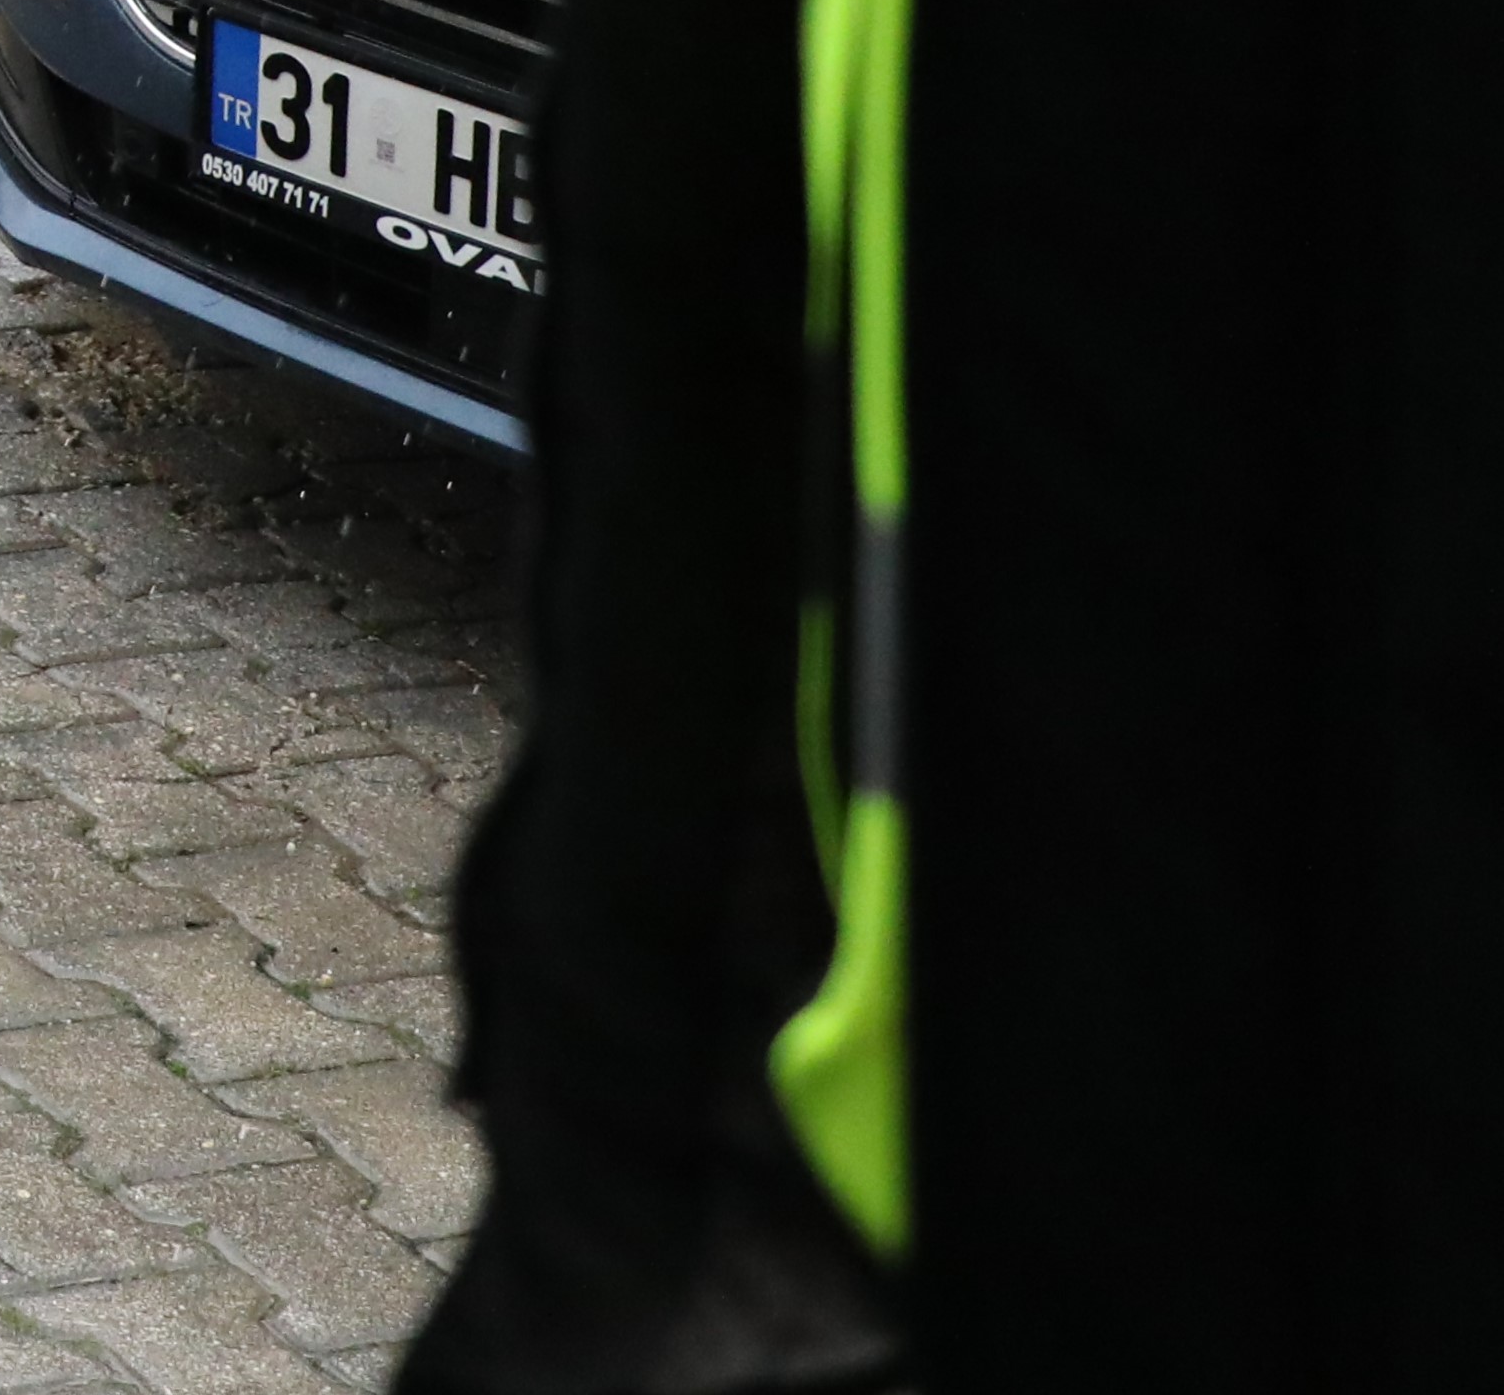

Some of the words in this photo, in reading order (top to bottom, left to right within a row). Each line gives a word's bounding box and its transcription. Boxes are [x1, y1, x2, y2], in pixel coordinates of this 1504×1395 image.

[218, 92, 253, 130] TR
[260, 52, 350, 178] 31
[201, 152, 244, 187] 0530
[246, 170, 279, 199] 407
[282, 181, 304, 209] 71
[308, 191, 330, 219] 71
[376, 215, 545, 296] OVA
